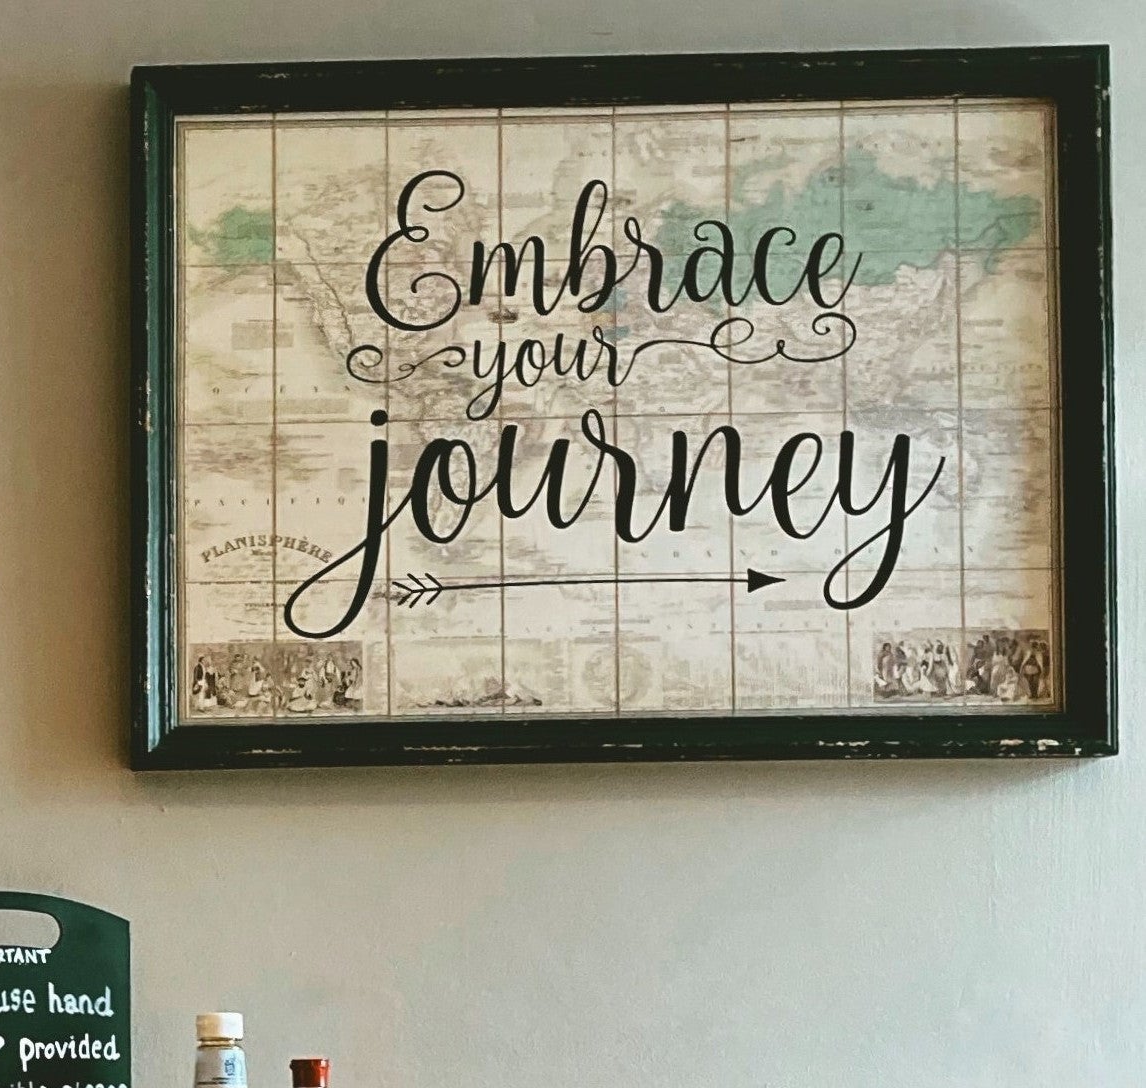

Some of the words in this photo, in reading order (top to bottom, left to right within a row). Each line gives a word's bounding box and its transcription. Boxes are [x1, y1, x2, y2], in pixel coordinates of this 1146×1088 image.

[364, 169, 862, 332] Embrace
[466, 326, 636, 420] your
[284, 409, 946, 639] journey
[48, 982, 114, 1017] hand
[19, 1033, 121, 1072] provided
